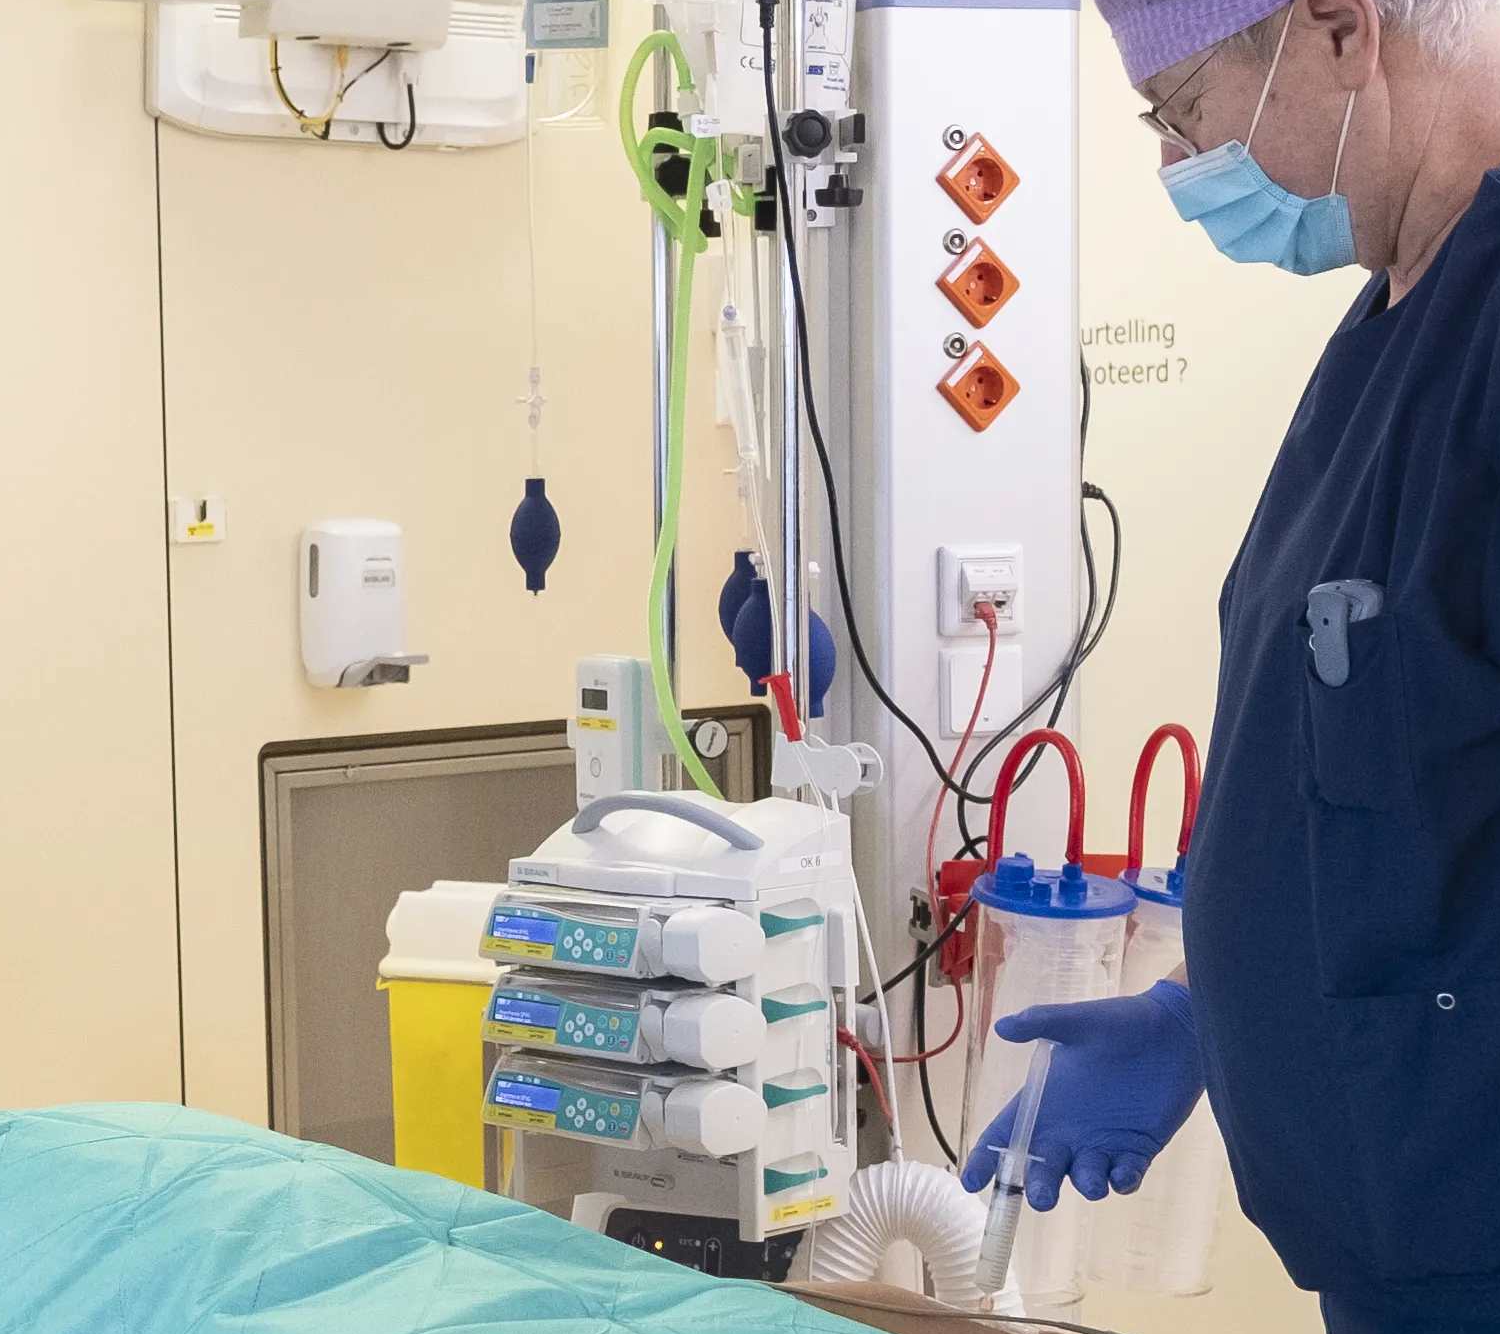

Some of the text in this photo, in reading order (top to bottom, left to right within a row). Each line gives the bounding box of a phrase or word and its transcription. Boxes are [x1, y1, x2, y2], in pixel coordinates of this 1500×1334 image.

[1081, 319, 1175, 349] urtelling
[800, 855, 821, 868] OK 6
